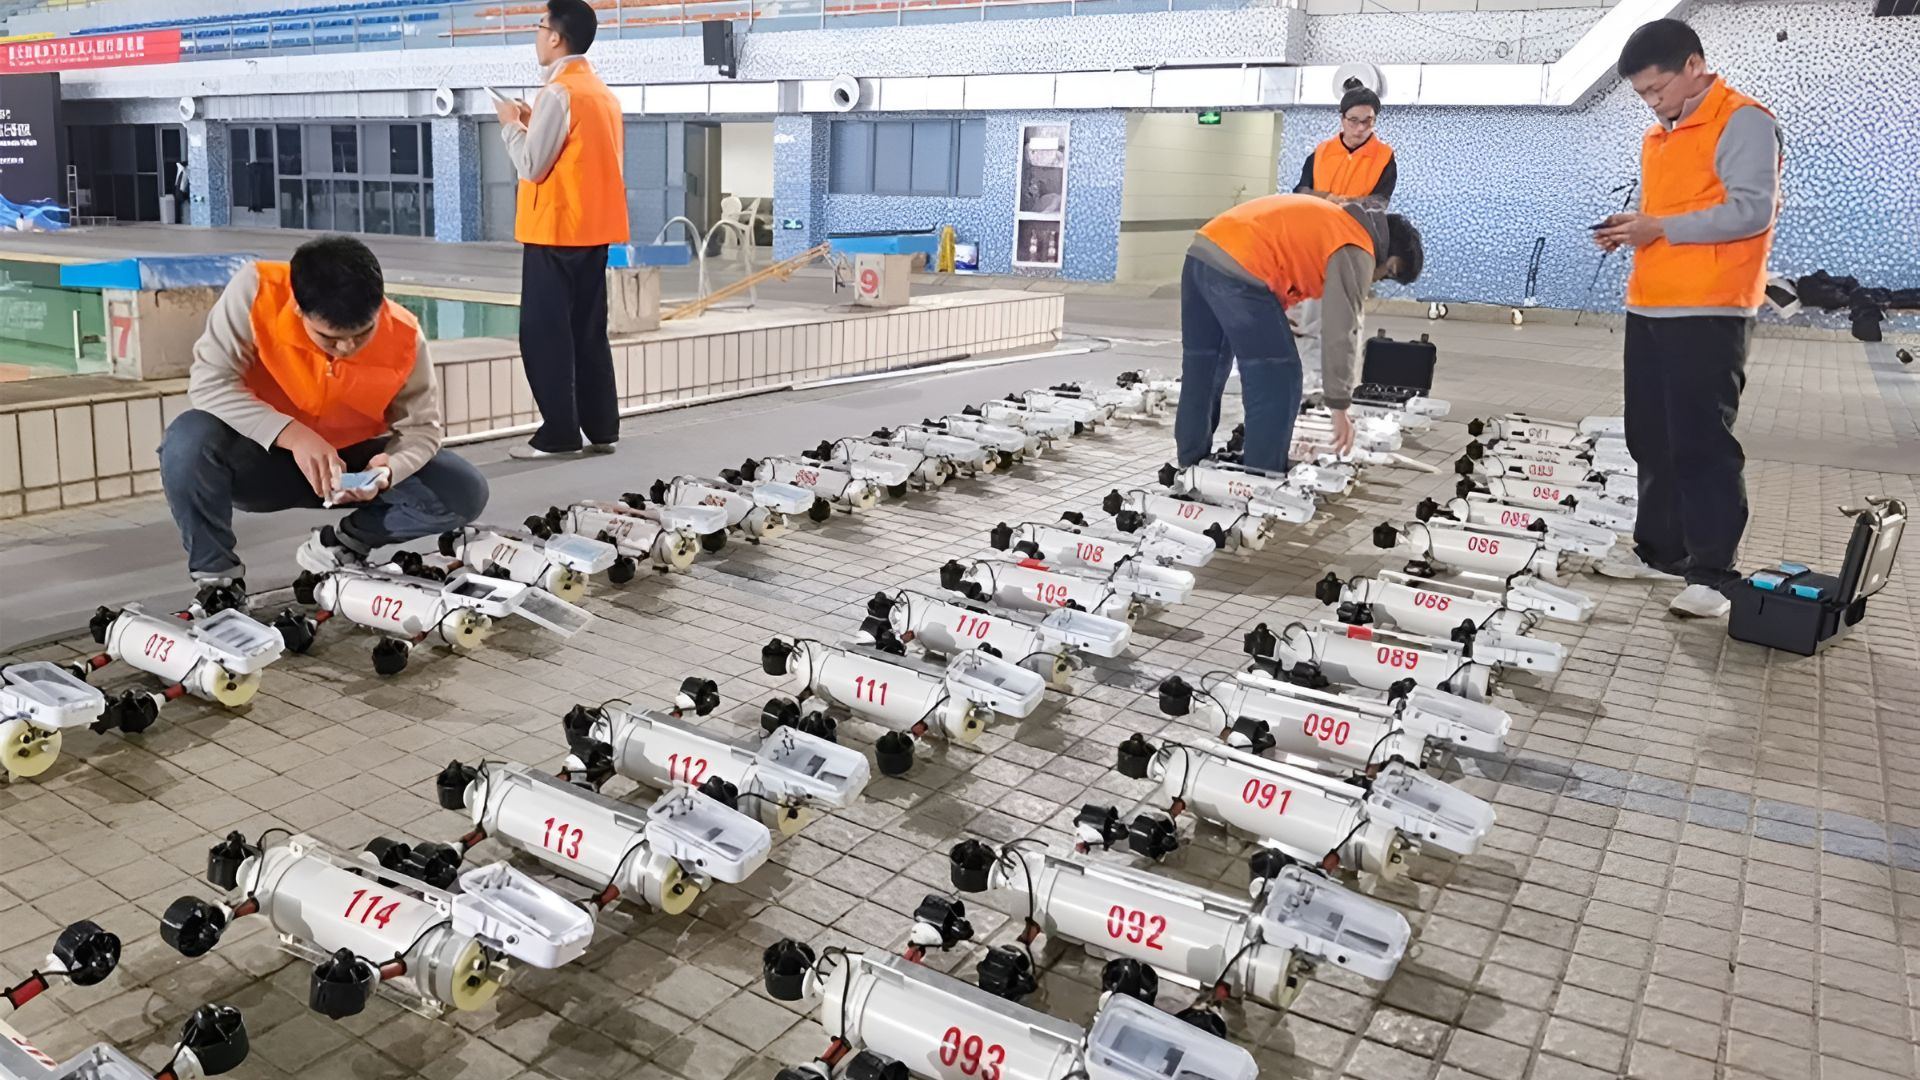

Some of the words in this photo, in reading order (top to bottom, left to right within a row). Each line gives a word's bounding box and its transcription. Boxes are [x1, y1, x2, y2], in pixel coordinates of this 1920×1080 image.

[860, 269, 879, 294] 9
[112, 315, 134, 358] 7
[1177, 503, 1204, 520] 107
[1078, 543, 1105, 563] 108
[1468, 536, 1500, 557] 086
[371, 594, 403, 621] 072
[1035, 582, 1068, 607] 109
[955, 614, 992, 641] 110
[145, 633, 175, 662] 073
[1376, 647, 1419, 671] 089
[855, 675, 888, 705] 111
[1304, 714, 1351, 746] 090
[668, 753, 708, 787] 112
[1242, 778, 1292, 815] 091
[543, 817, 584, 860] 113
[344, 889, 400, 930] 114
[1106, 905, 1168, 951] 092
[939, 1026, 1006, 1080] 093
